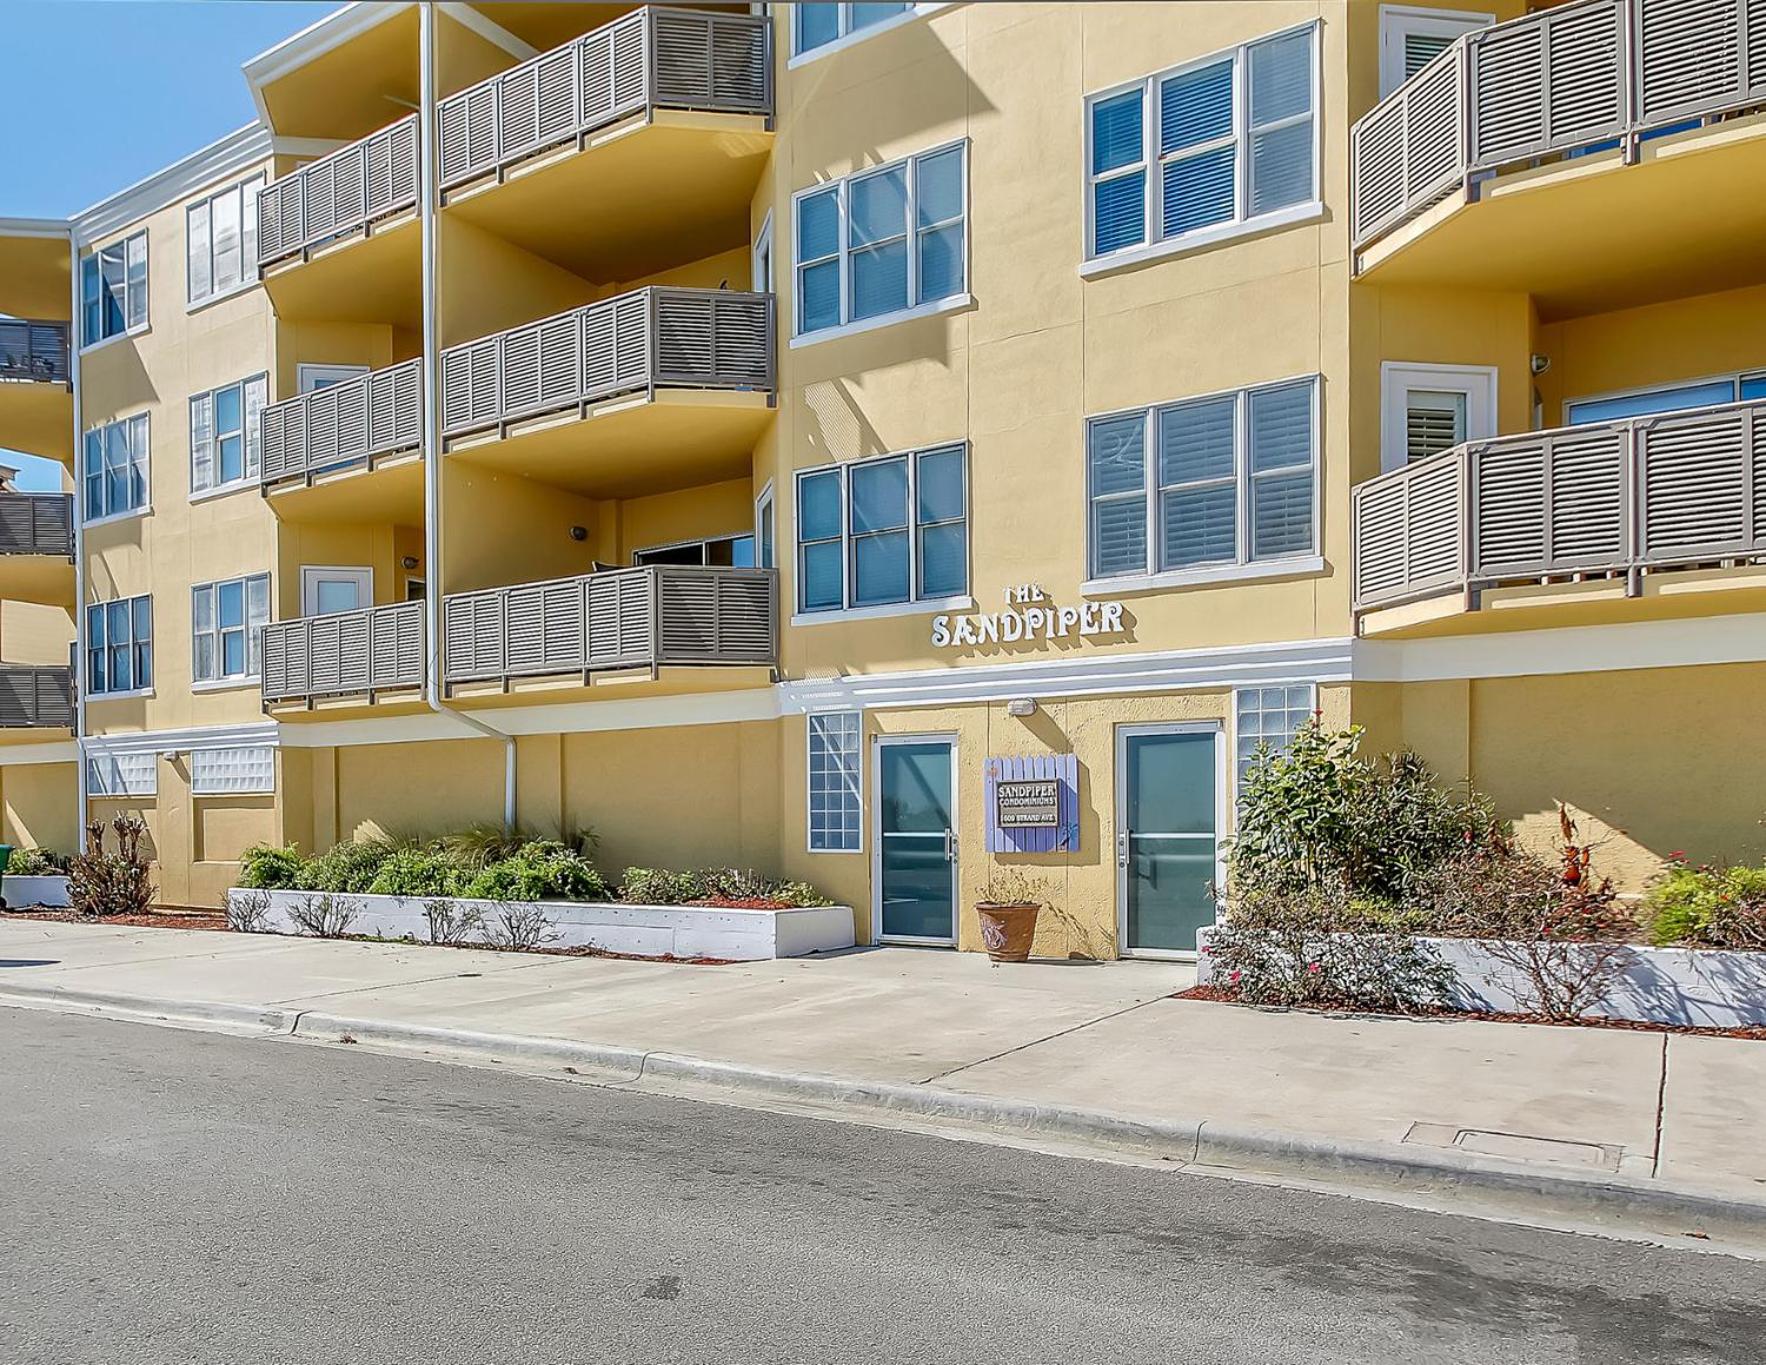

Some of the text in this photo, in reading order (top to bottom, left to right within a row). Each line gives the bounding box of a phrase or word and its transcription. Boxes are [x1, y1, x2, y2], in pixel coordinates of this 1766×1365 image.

[1003, 582, 1044, 603] THE
[931, 602, 1125, 647] SANDPIPER
[998, 785, 1055, 797] SANDPIPER
[999, 797, 1054, 806] CONDOMINIUMS
